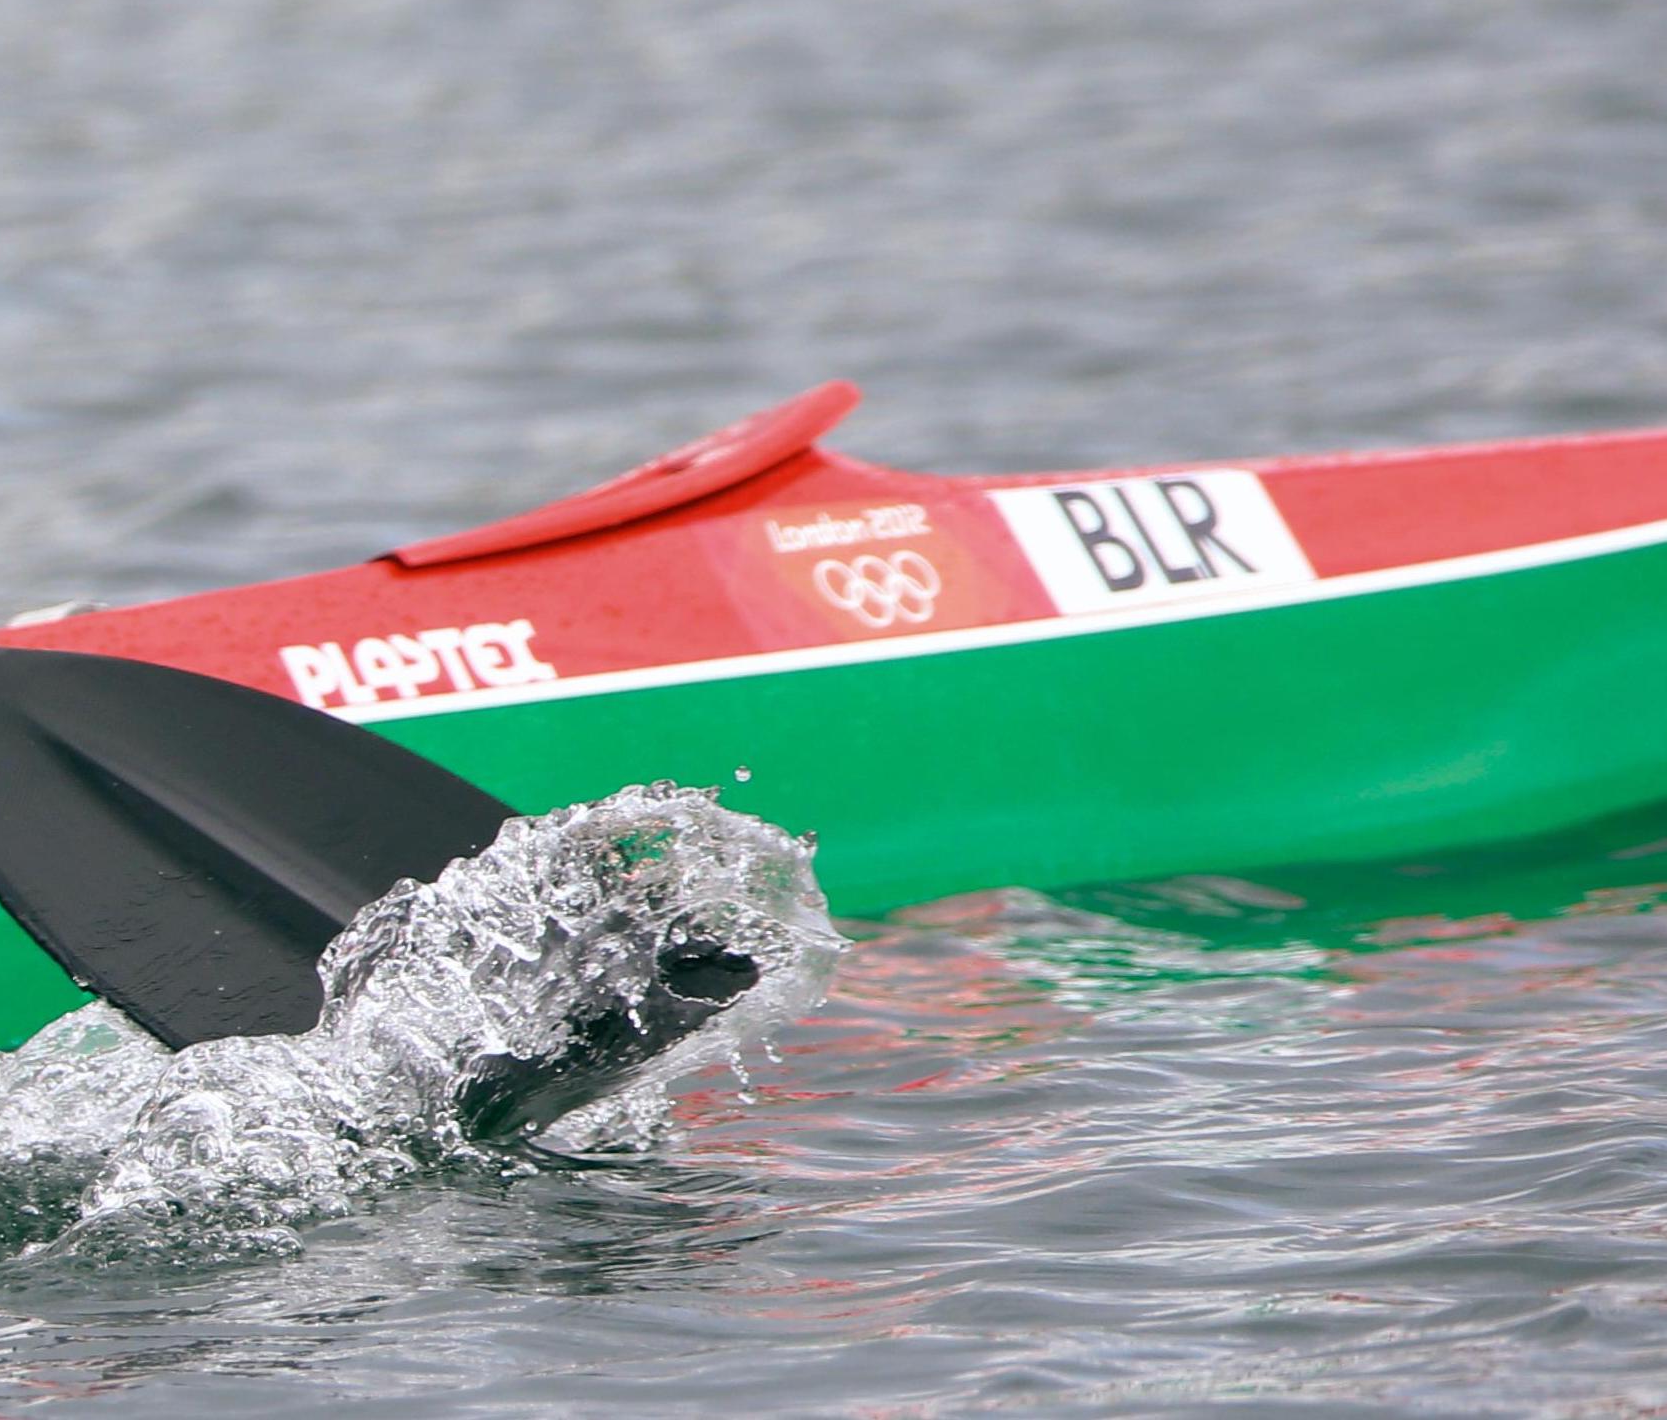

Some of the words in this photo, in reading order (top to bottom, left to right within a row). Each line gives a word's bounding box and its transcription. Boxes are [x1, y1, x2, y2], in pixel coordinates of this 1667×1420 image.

[764, 511, 866, 553] London
[861, 503, 932, 541] 2012
[1051, 478, 1260, 593] BLR
